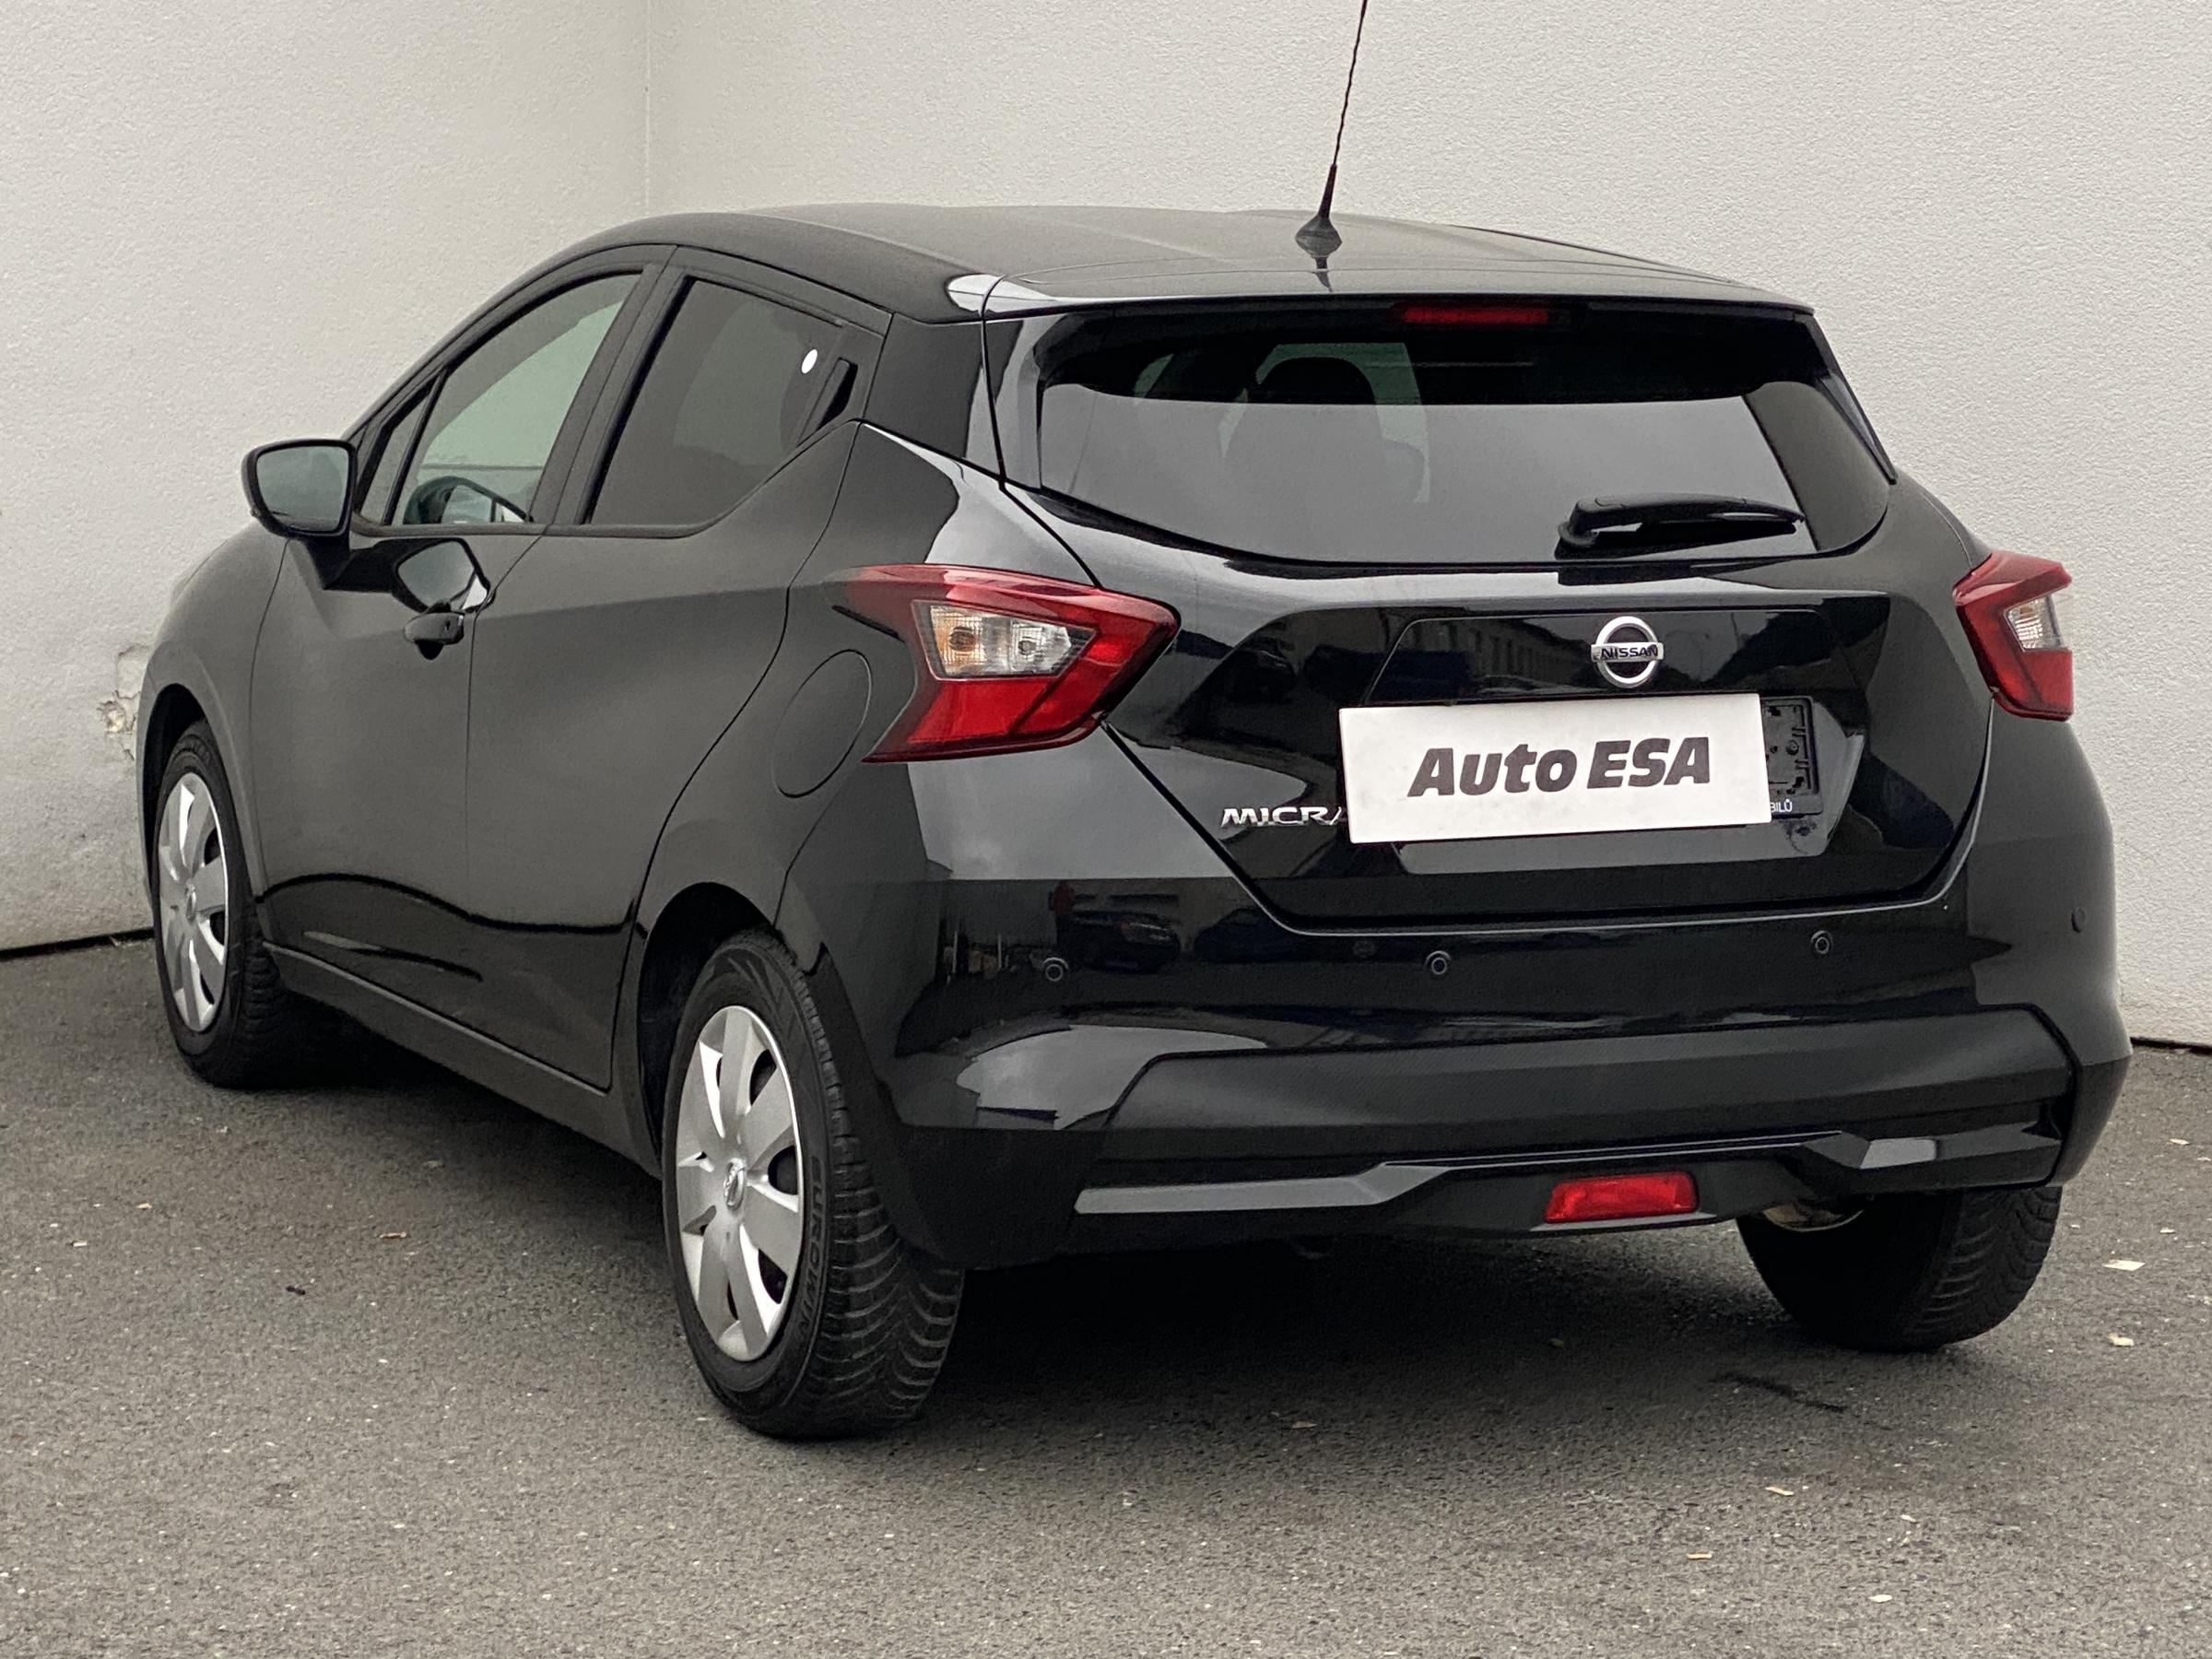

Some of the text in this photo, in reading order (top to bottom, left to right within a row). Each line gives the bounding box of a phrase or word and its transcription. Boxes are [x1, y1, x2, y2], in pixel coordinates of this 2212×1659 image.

[1600, 644, 1658, 661] NISSAN
[1406, 736, 1710, 797] Auto ESA
